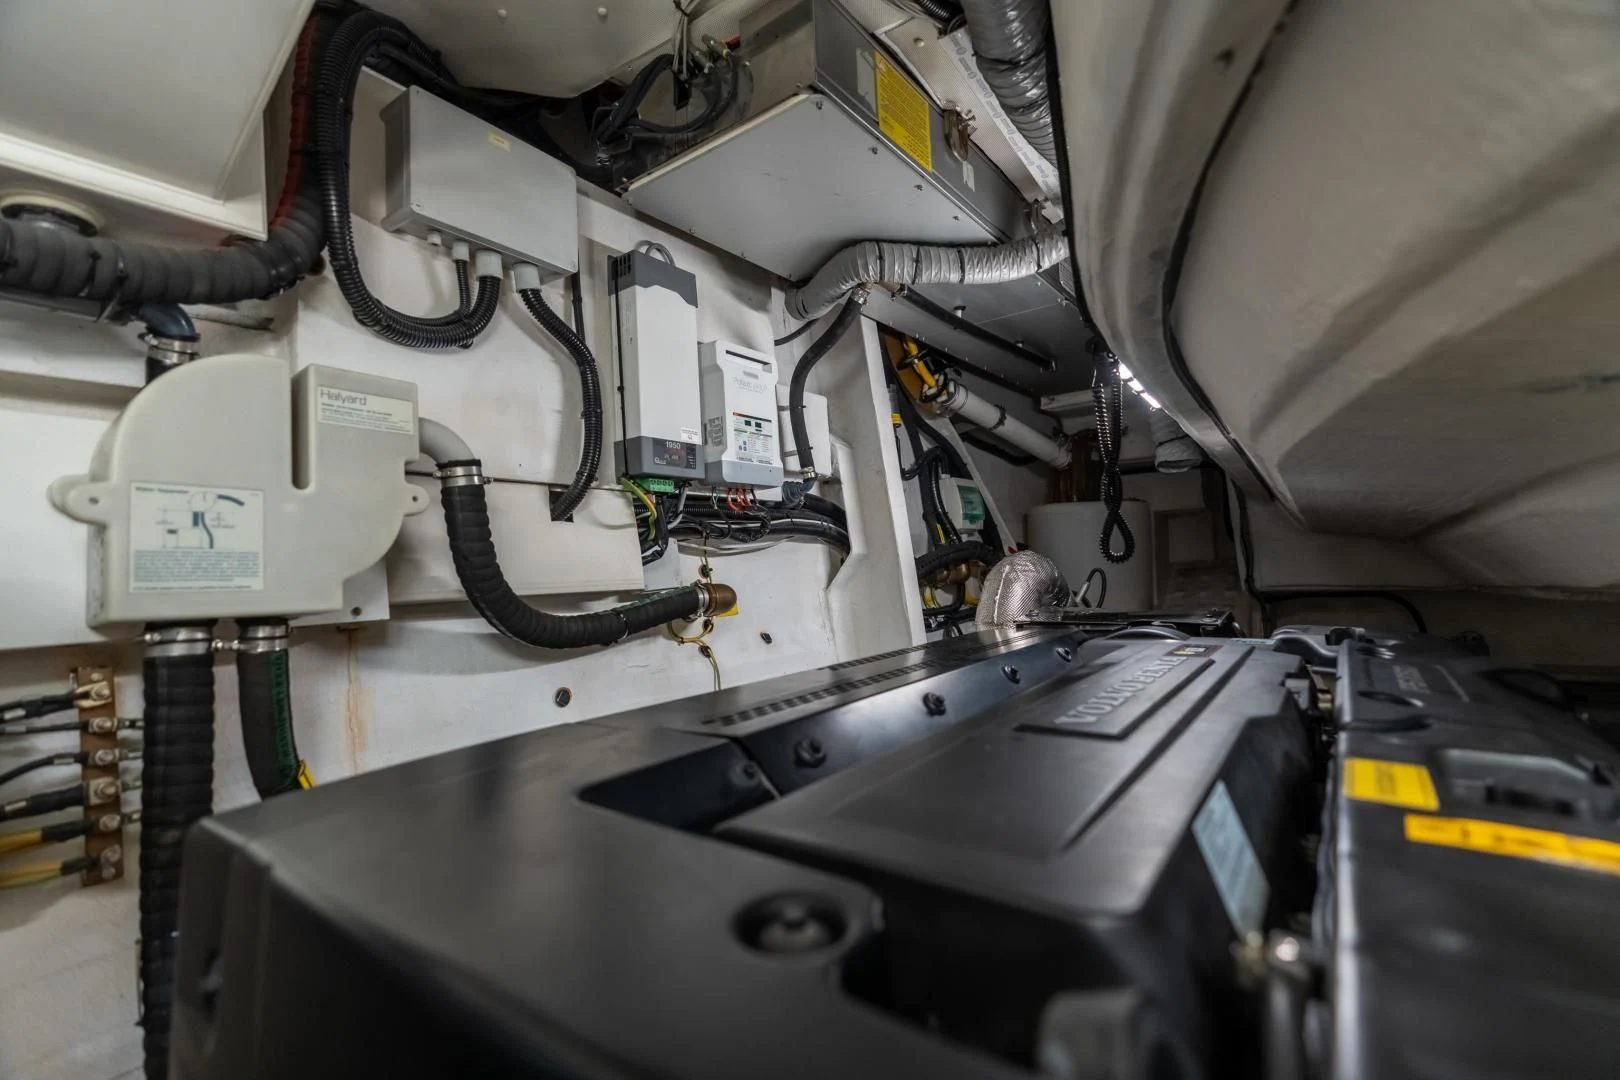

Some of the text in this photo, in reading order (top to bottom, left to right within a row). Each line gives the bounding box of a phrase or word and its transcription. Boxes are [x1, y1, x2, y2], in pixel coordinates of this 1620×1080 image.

[320, 389, 367, 406] Halyard
[666, 441, 680, 449] 1950
[1054, 680, 1145, 724] VOLVO
